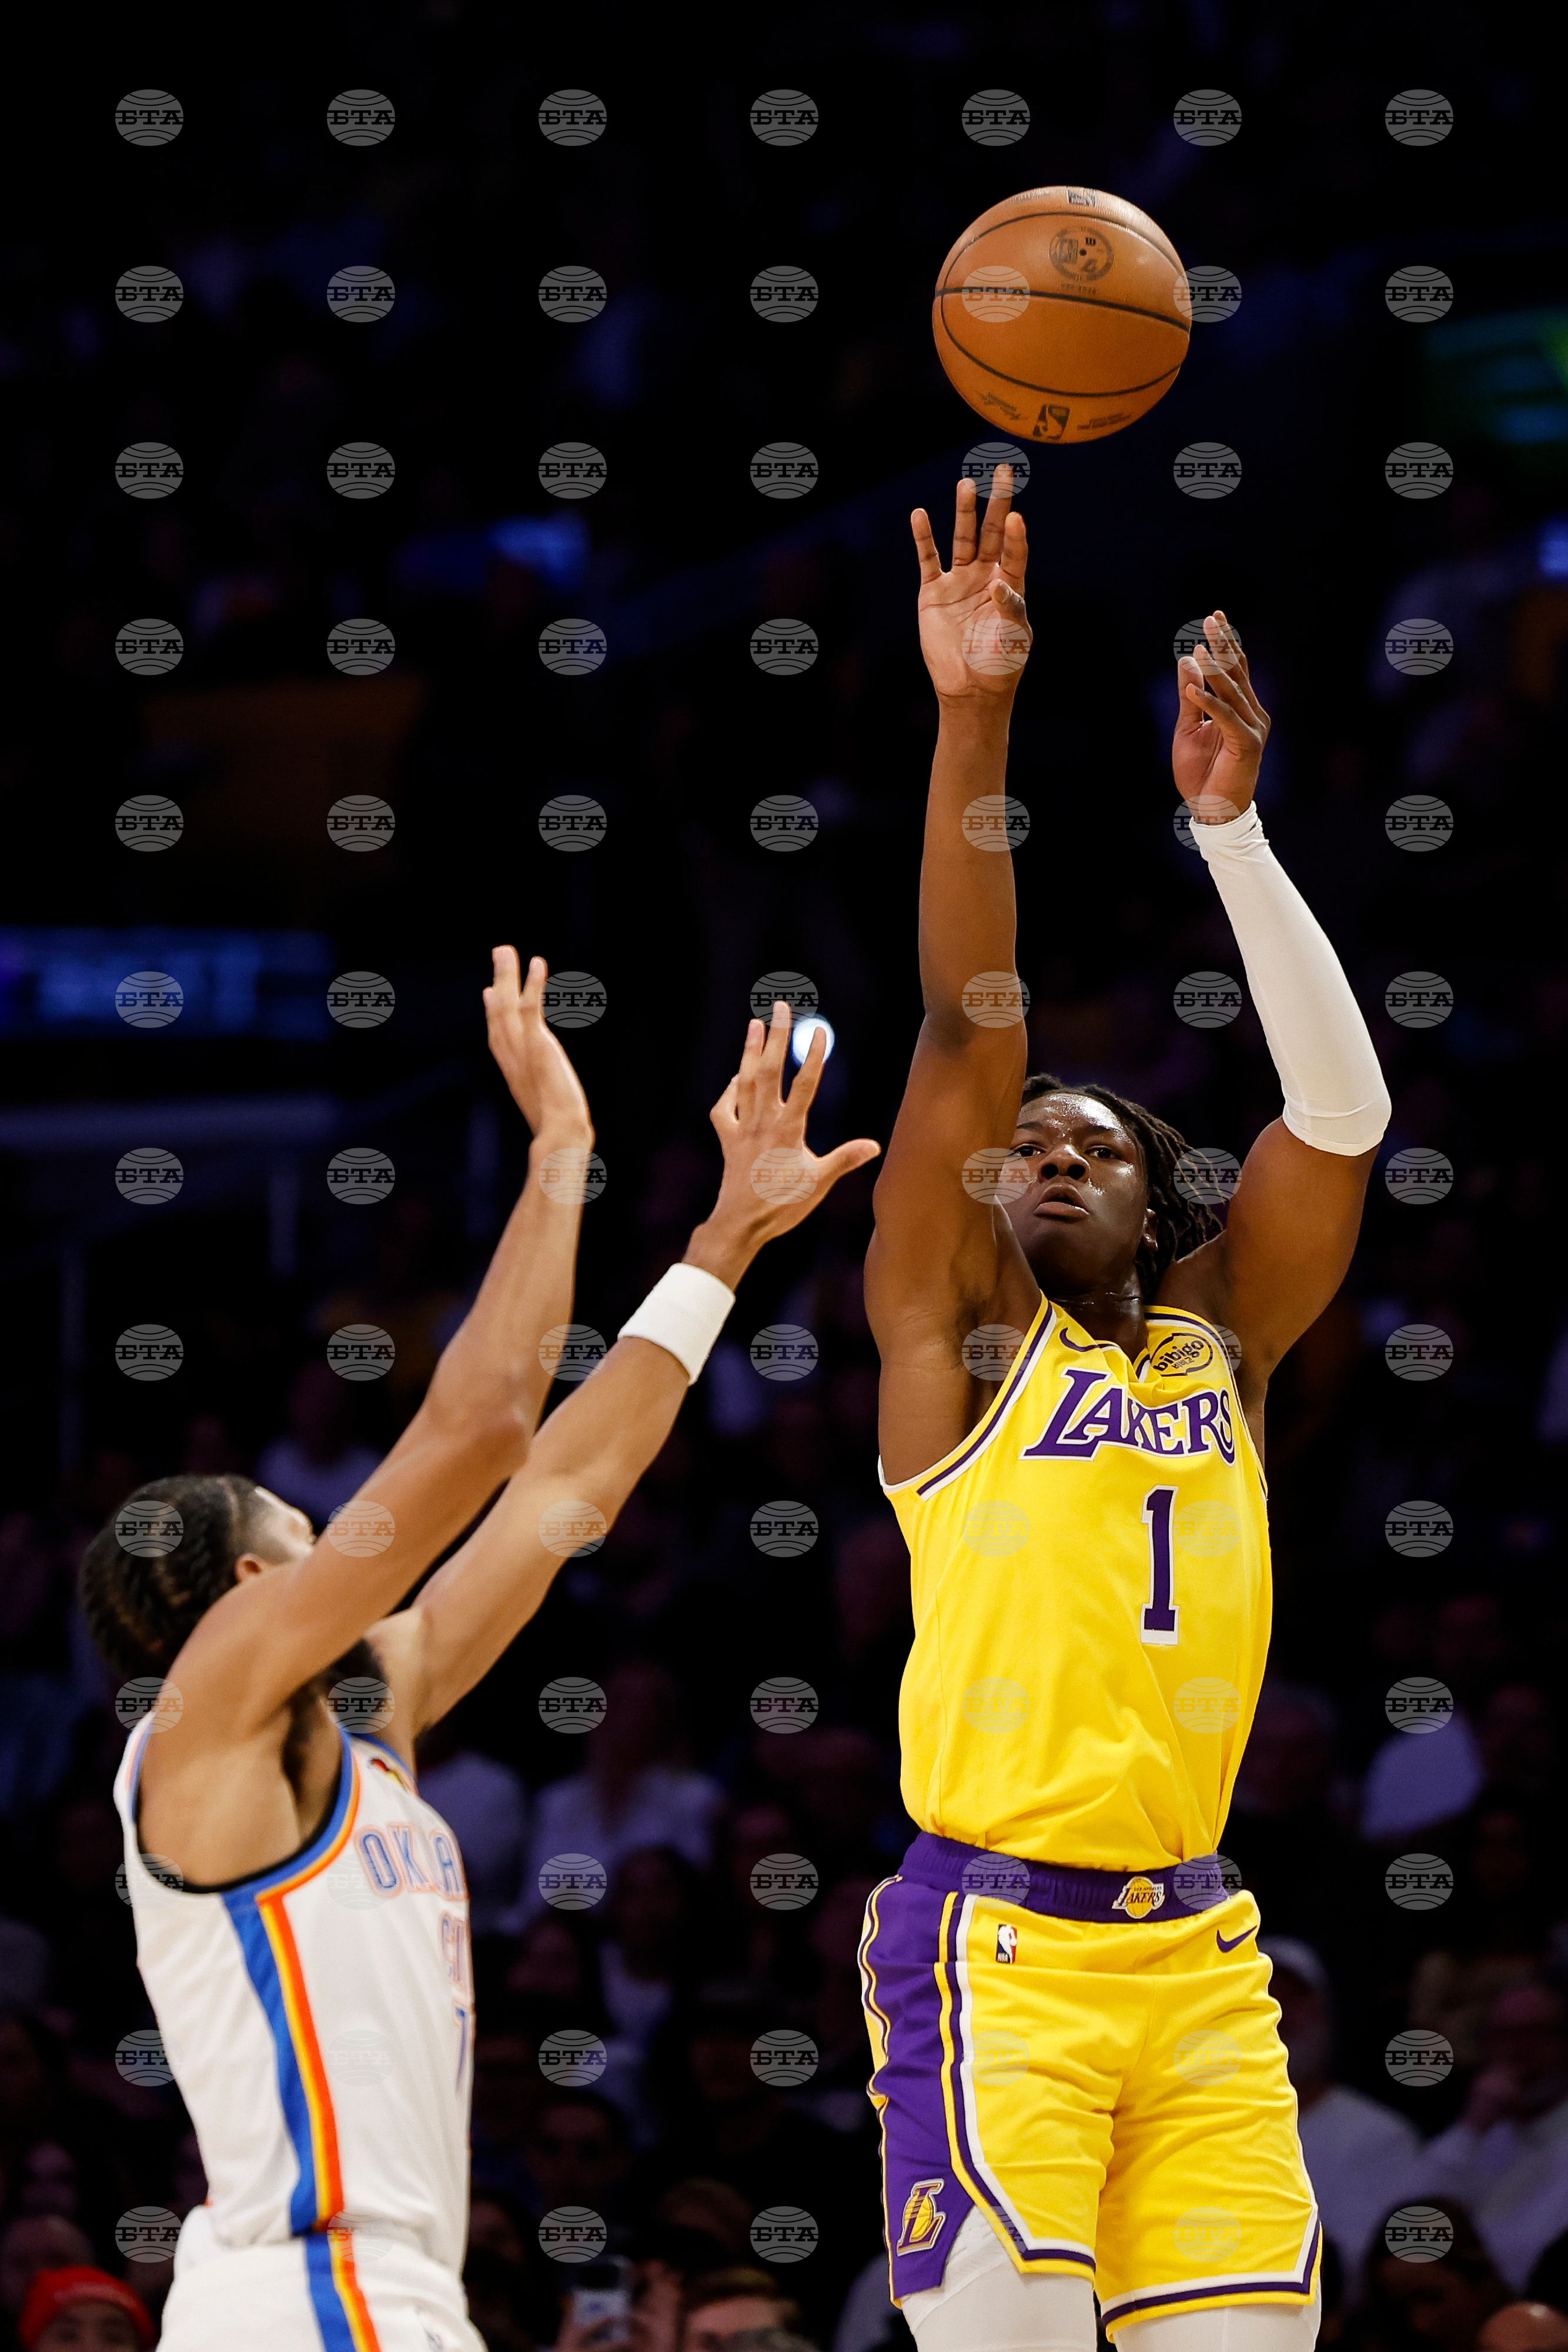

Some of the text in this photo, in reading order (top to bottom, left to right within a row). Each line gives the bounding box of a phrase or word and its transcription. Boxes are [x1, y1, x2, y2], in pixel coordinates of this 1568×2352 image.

[1152, 1340, 1204, 1371] bibigo
[1019, 1367, 1236, 1467] LAKERS
[1140, 1485, 1179, 1646] 1
[1112, 1884, 1165, 1910] LAKERS
[997, 1952, 1008, 1963] NBA
